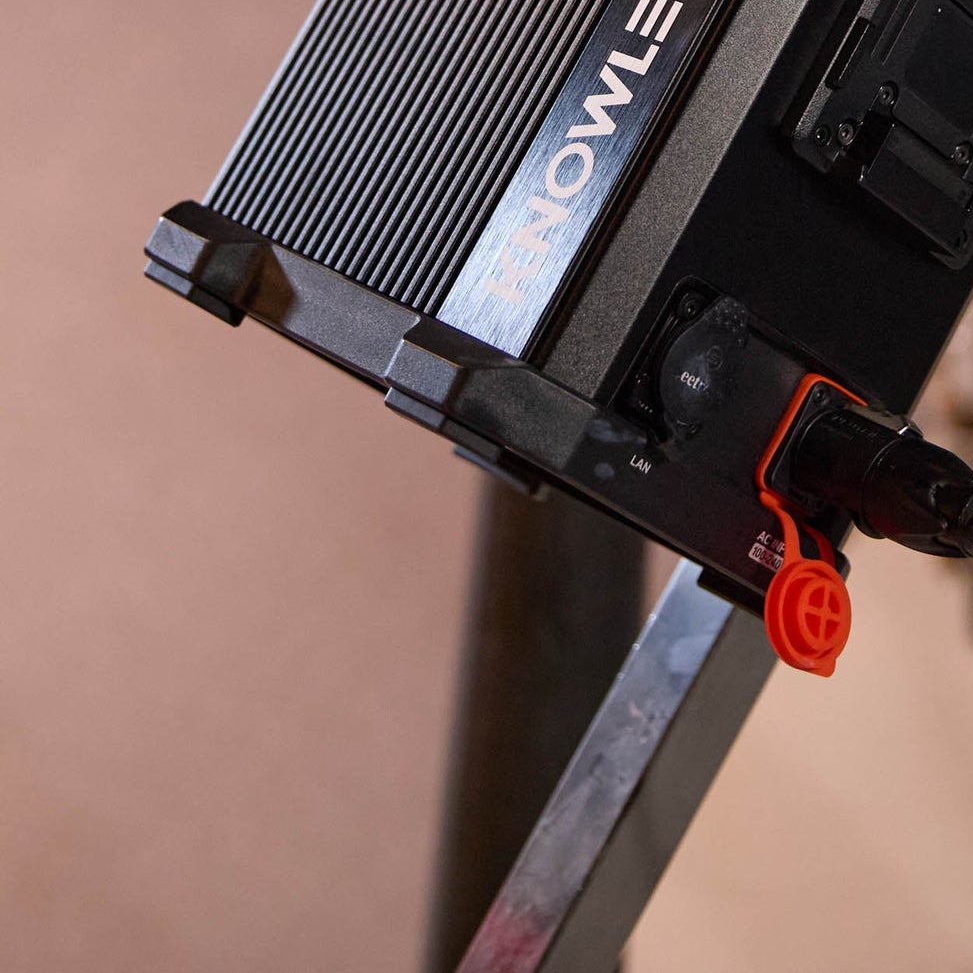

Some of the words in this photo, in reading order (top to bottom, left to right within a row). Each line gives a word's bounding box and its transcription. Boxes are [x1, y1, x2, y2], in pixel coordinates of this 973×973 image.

[630, 454, 652, 474] LAN
[756, 530, 771, 545] AC
[770, 538, 785, 553] INP
[751, 545, 783, 569] 100-240
